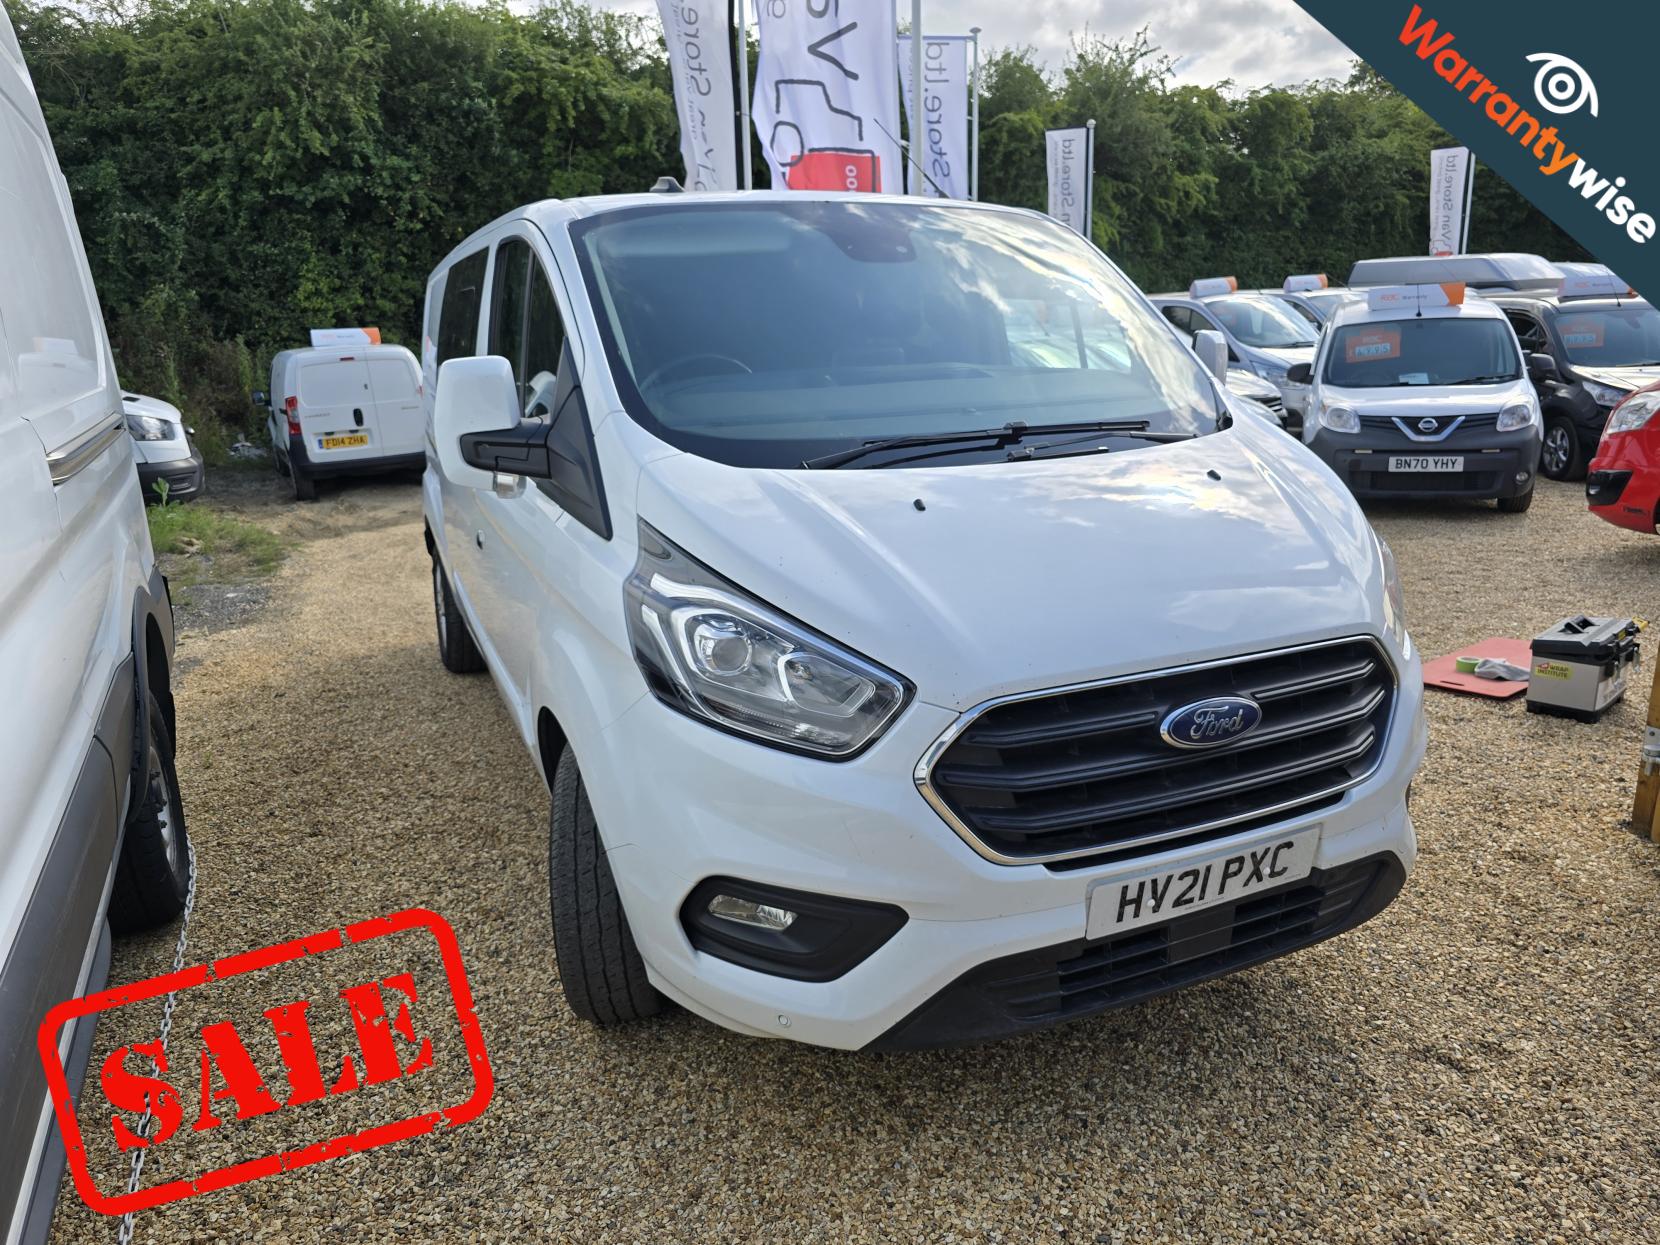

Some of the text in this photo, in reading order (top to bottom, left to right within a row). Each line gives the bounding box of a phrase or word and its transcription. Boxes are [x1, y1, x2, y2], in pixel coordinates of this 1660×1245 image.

[1395, 458, 1458, 470] BN70 YHY
[1190, 705, 1243, 739] Ford
[1116, 840, 1294, 923] HV21 PXC
